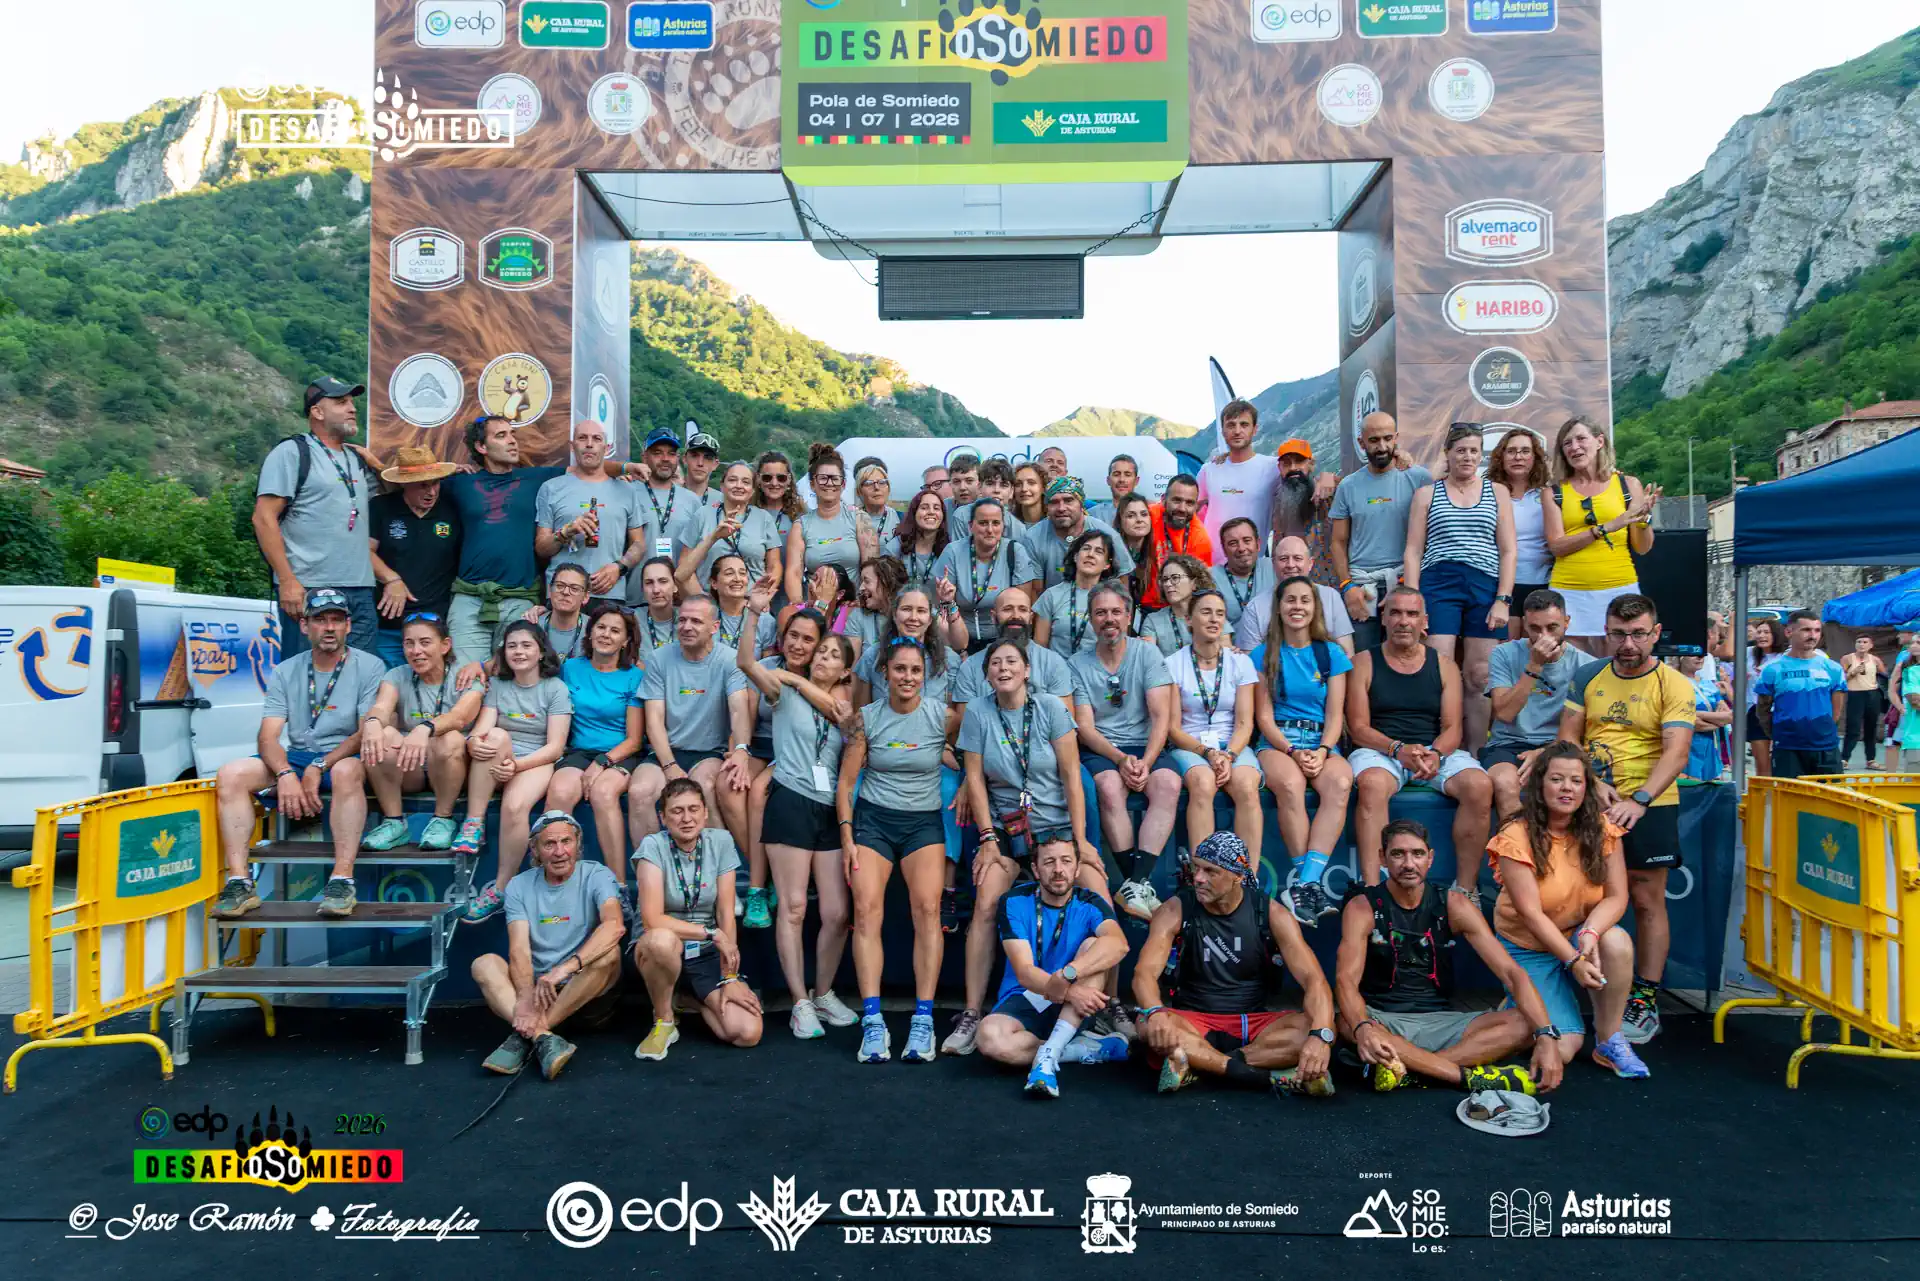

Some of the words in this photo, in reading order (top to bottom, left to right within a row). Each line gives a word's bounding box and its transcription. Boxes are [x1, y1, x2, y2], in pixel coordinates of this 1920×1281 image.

[1388, 5, 1410, 14] CAJA
[1411, 4, 1443, 14] RURAL
[1503, 1, 1549, 12] Asturias
[454, 10, 496, 35] edp
[550, 18, 573, 27] CAJA
[573, 18, 605, 28] RURAL
[1290, 5, 1332, 28] edp
[663, 18, 707, 30] Asturias
[1357, 83, 1370, 91] SO
[516, 101, 532, 109] MIE
[809, 94, 849, 108] Pola
[855, 94, 876, 108] de
[882, 94, 959, 108] Somiedo
[809, 113, 835, 126] 04
[861, 113, 885, 126] 07
[911, 113, 960, 127] 2026
[1059, 113, 1091, 126] CAJA
[1094, 113, 1140, 125] RURAL
[1060, 127, 1072, 135] DE
[1074, 126, 1117, 135] ASTURIAS
[1481, 232, 1518, 247] rent
[1476, 299, 1544, 317] HARIBO
[125, 866, 157, 884] CAJA
[159, 857, 197, 878] RURAL
[1802, 861, 1825, 880] CAJA
[1826, 867, 1856, 890] RURAL
